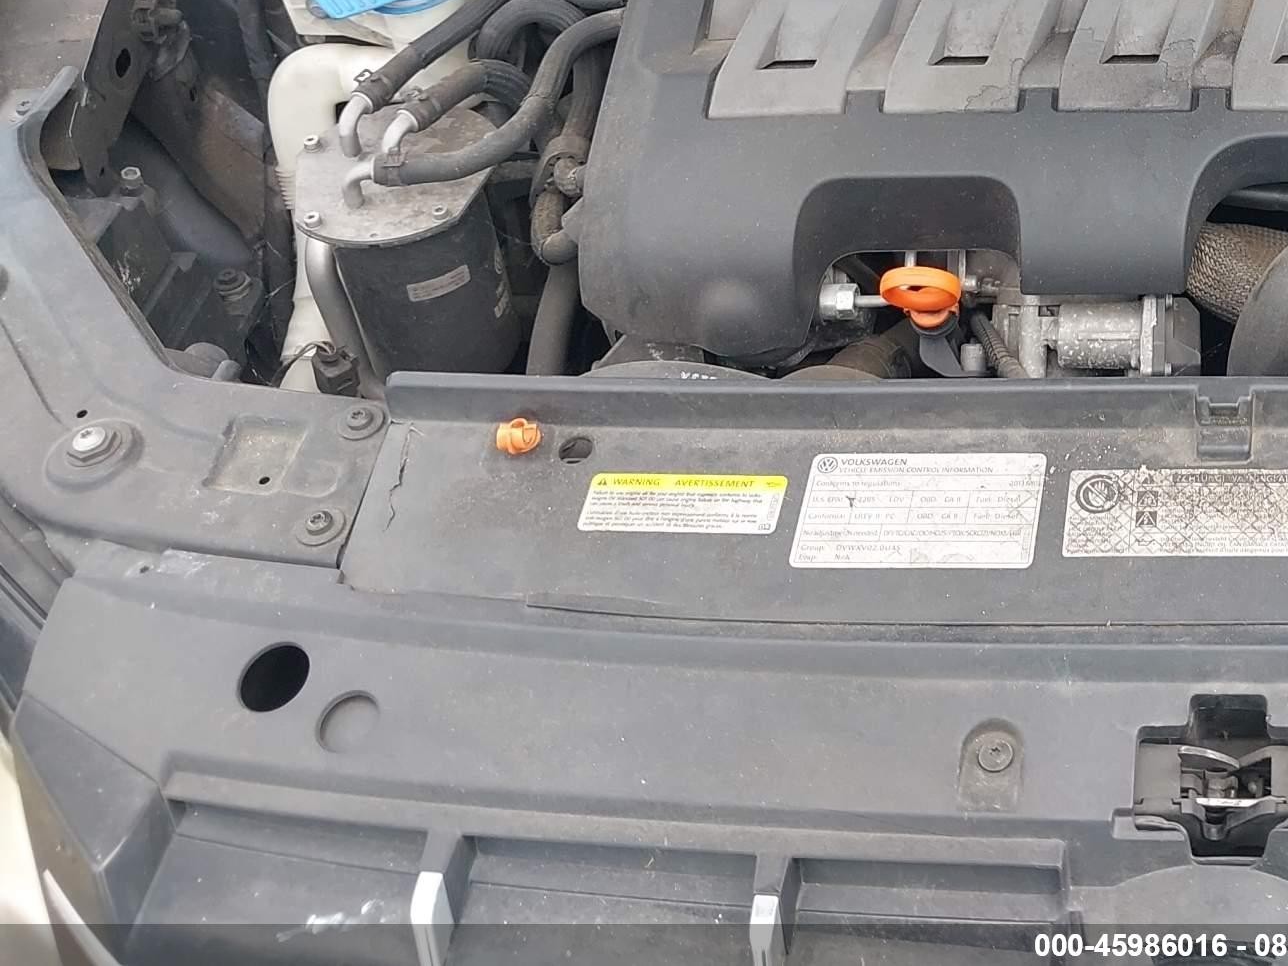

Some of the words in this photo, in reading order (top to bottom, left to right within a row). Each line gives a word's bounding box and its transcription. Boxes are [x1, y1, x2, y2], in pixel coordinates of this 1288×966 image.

[840, 458, 908, 466] VOLKSWAGEN
[868, 466, 905, 474] EMISSION
[906, 466, 939, 474] CONTROL
[941, 466, 994, 474] INFORMATION
[613, 478, 661, 487] WARNING
[674, 479, 756, 489] AVERTISSEMENT
